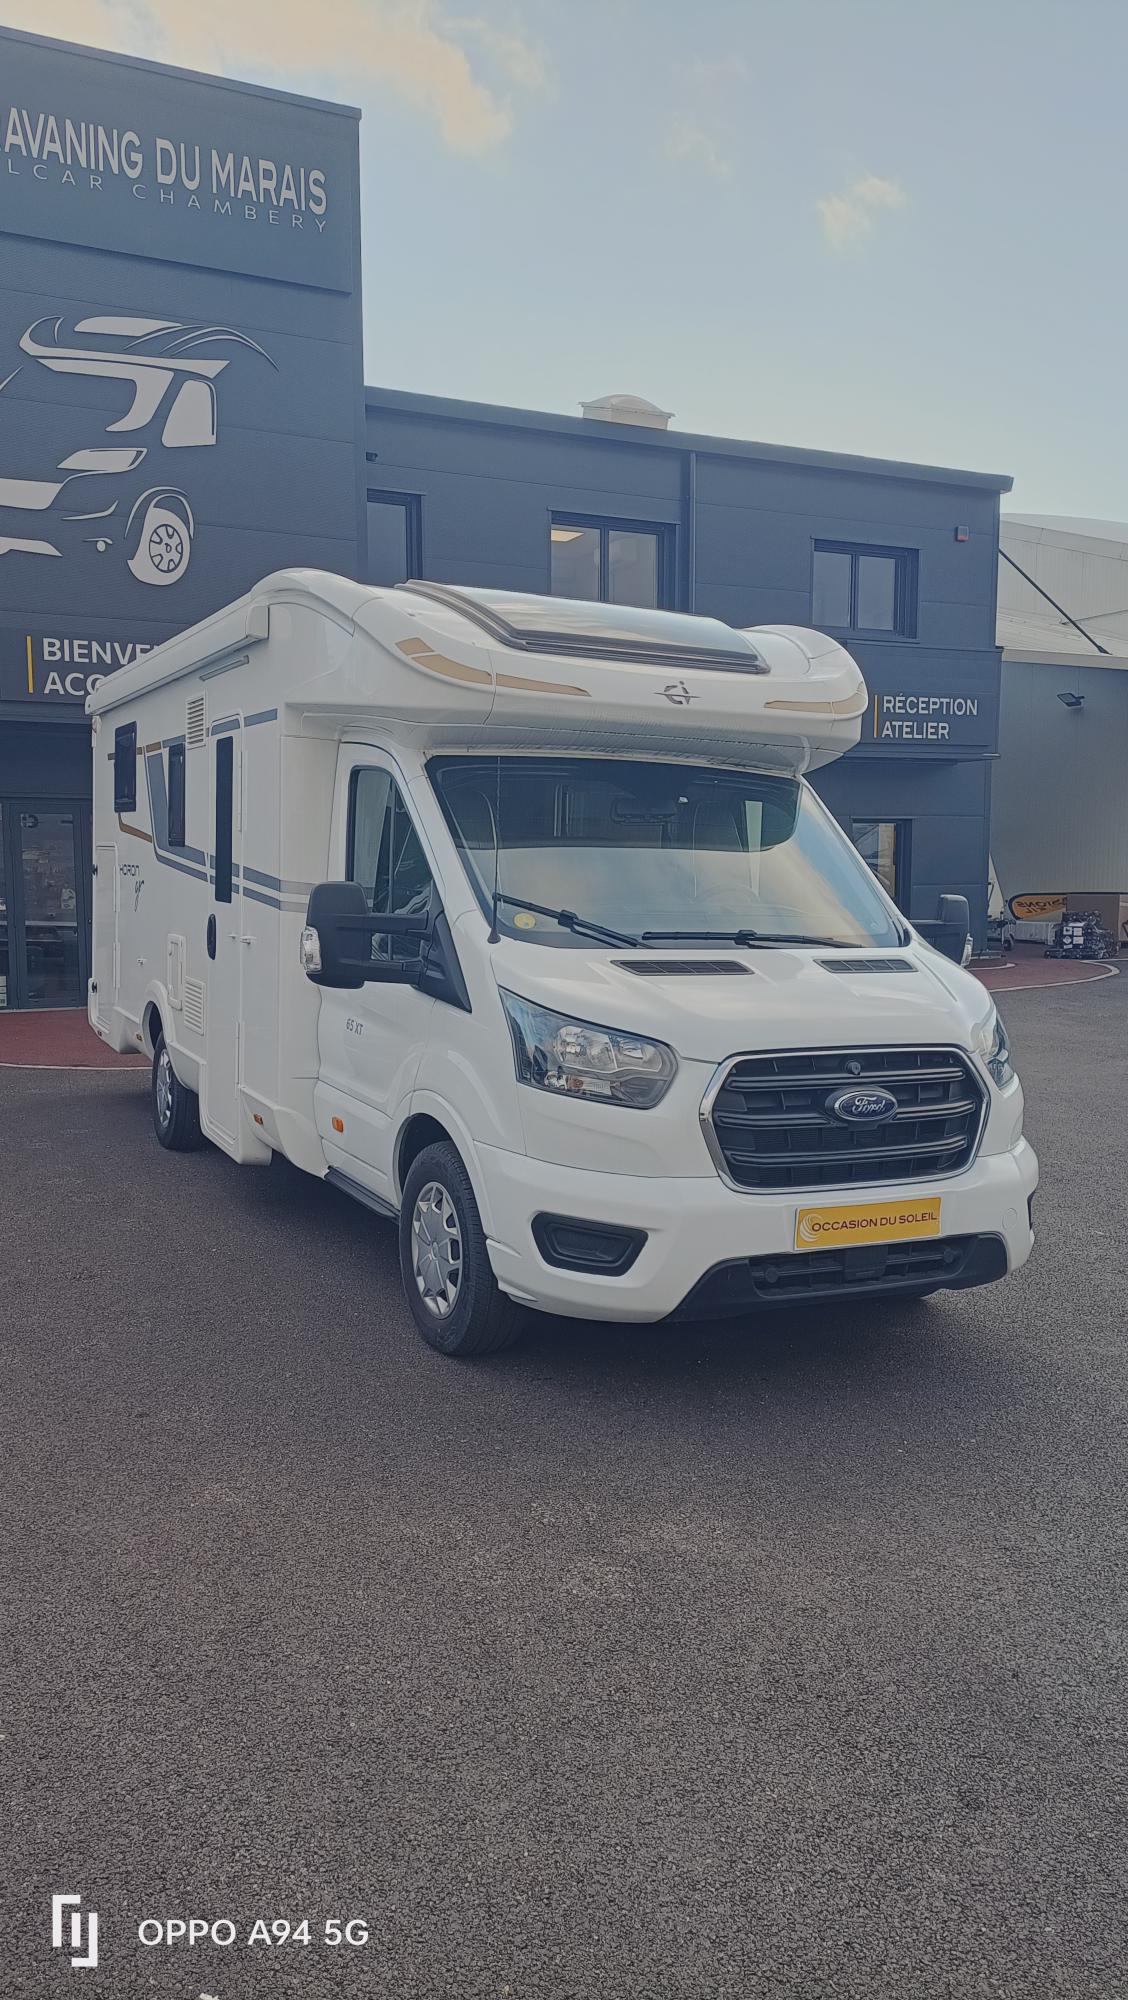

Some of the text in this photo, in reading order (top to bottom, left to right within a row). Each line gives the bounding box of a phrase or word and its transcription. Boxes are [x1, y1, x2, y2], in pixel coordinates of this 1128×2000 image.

[4, 106, 327, 215] AVANING DU MARAIS
[132, 184, 326, 233] CHAMBERY
[883, 693, 978, 716] RÉCEPTION
[881, 721, 949, 740] ATELIER
[346, 1018, 364, 1035] 65 XT
[852, 1096, 886, 1114] Ford
[811, 1211, 938, 1233] OCCASION DU SOLEIL
